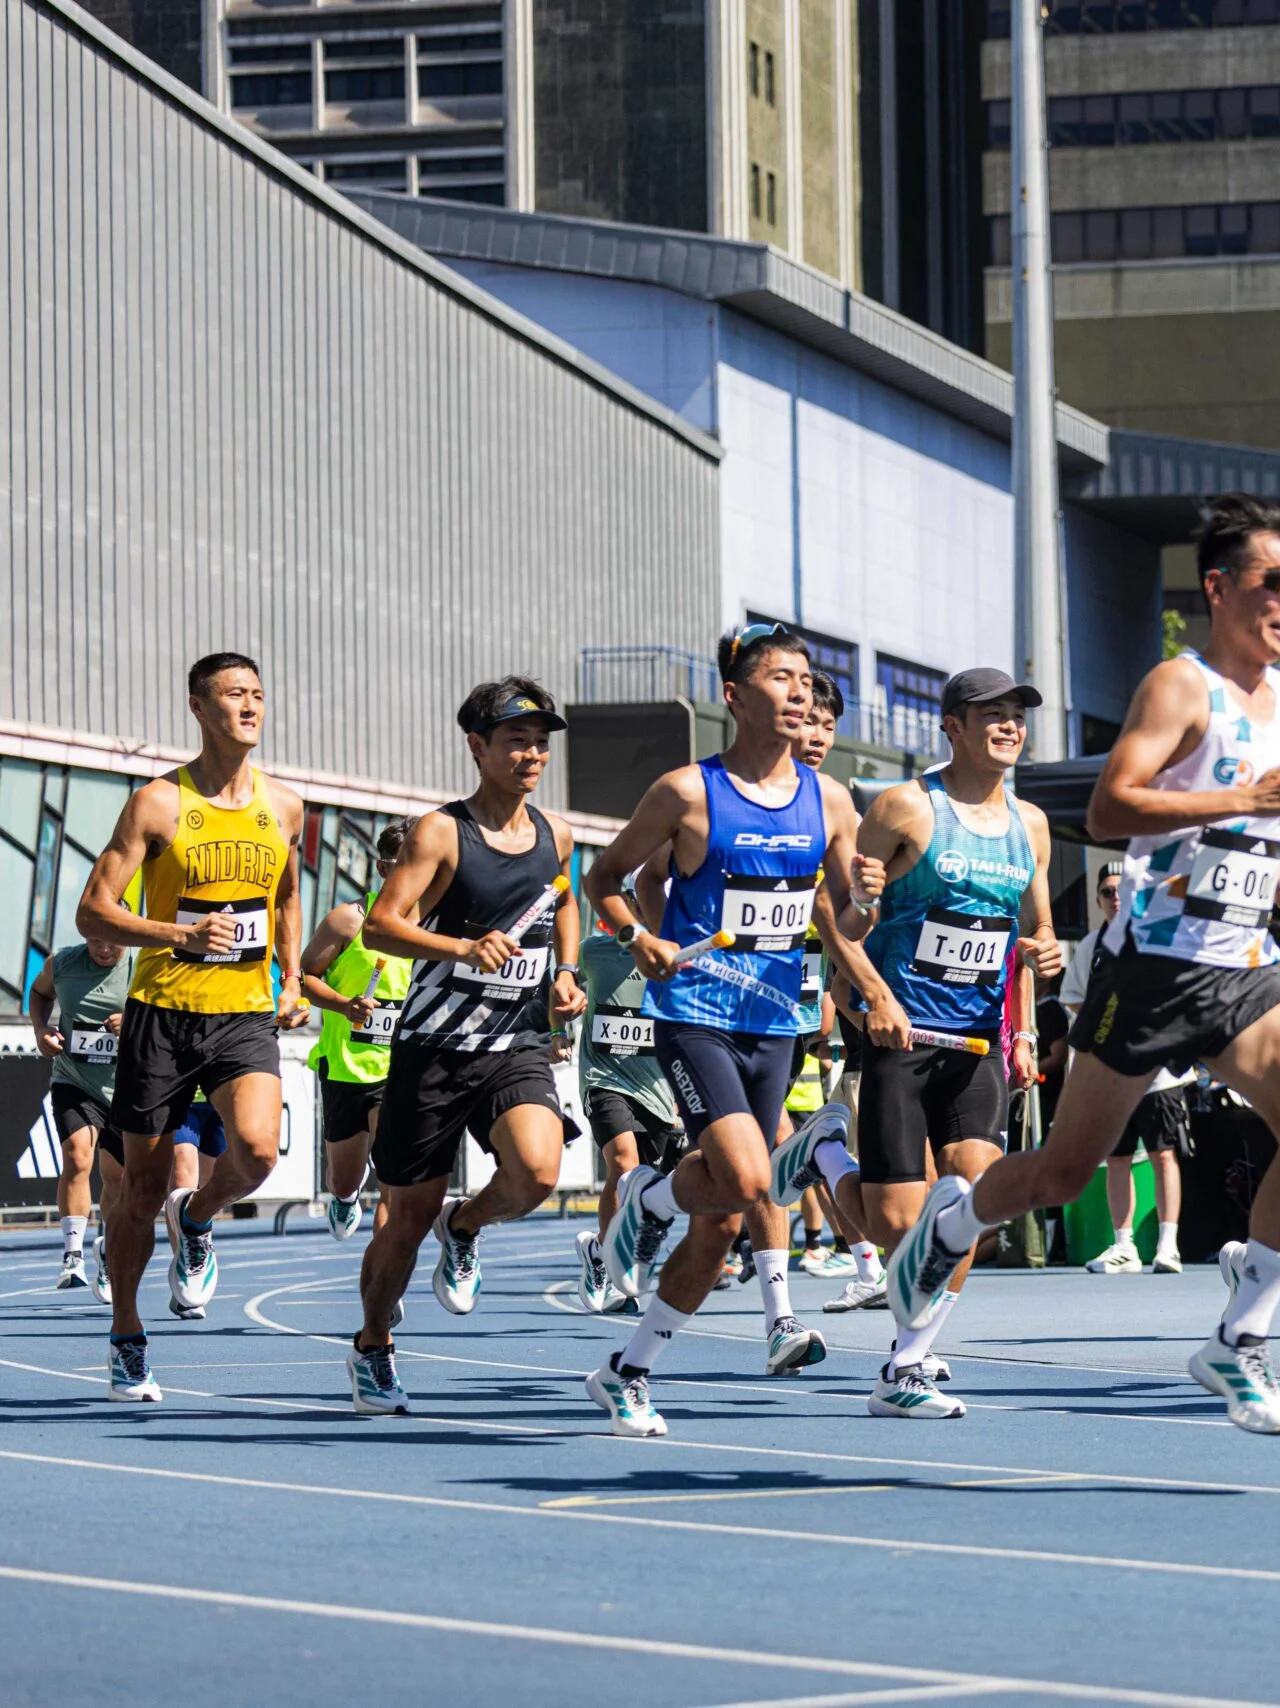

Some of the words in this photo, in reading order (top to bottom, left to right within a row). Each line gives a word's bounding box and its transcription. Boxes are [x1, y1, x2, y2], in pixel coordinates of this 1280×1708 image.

[186, 840, 276, 890] NIDRC
[1212, 864, 1269, 900] G-0
[741, 903, 805, 928] D-001
[935, 934, 996, 964] T-001
[714, 964, 745, 986] HIGH
[79, 1036, 119, 1052] Z-00
[600, 1022, 652, 1042] X-001
[671, 1059, 707, 1115] ADIZERO
